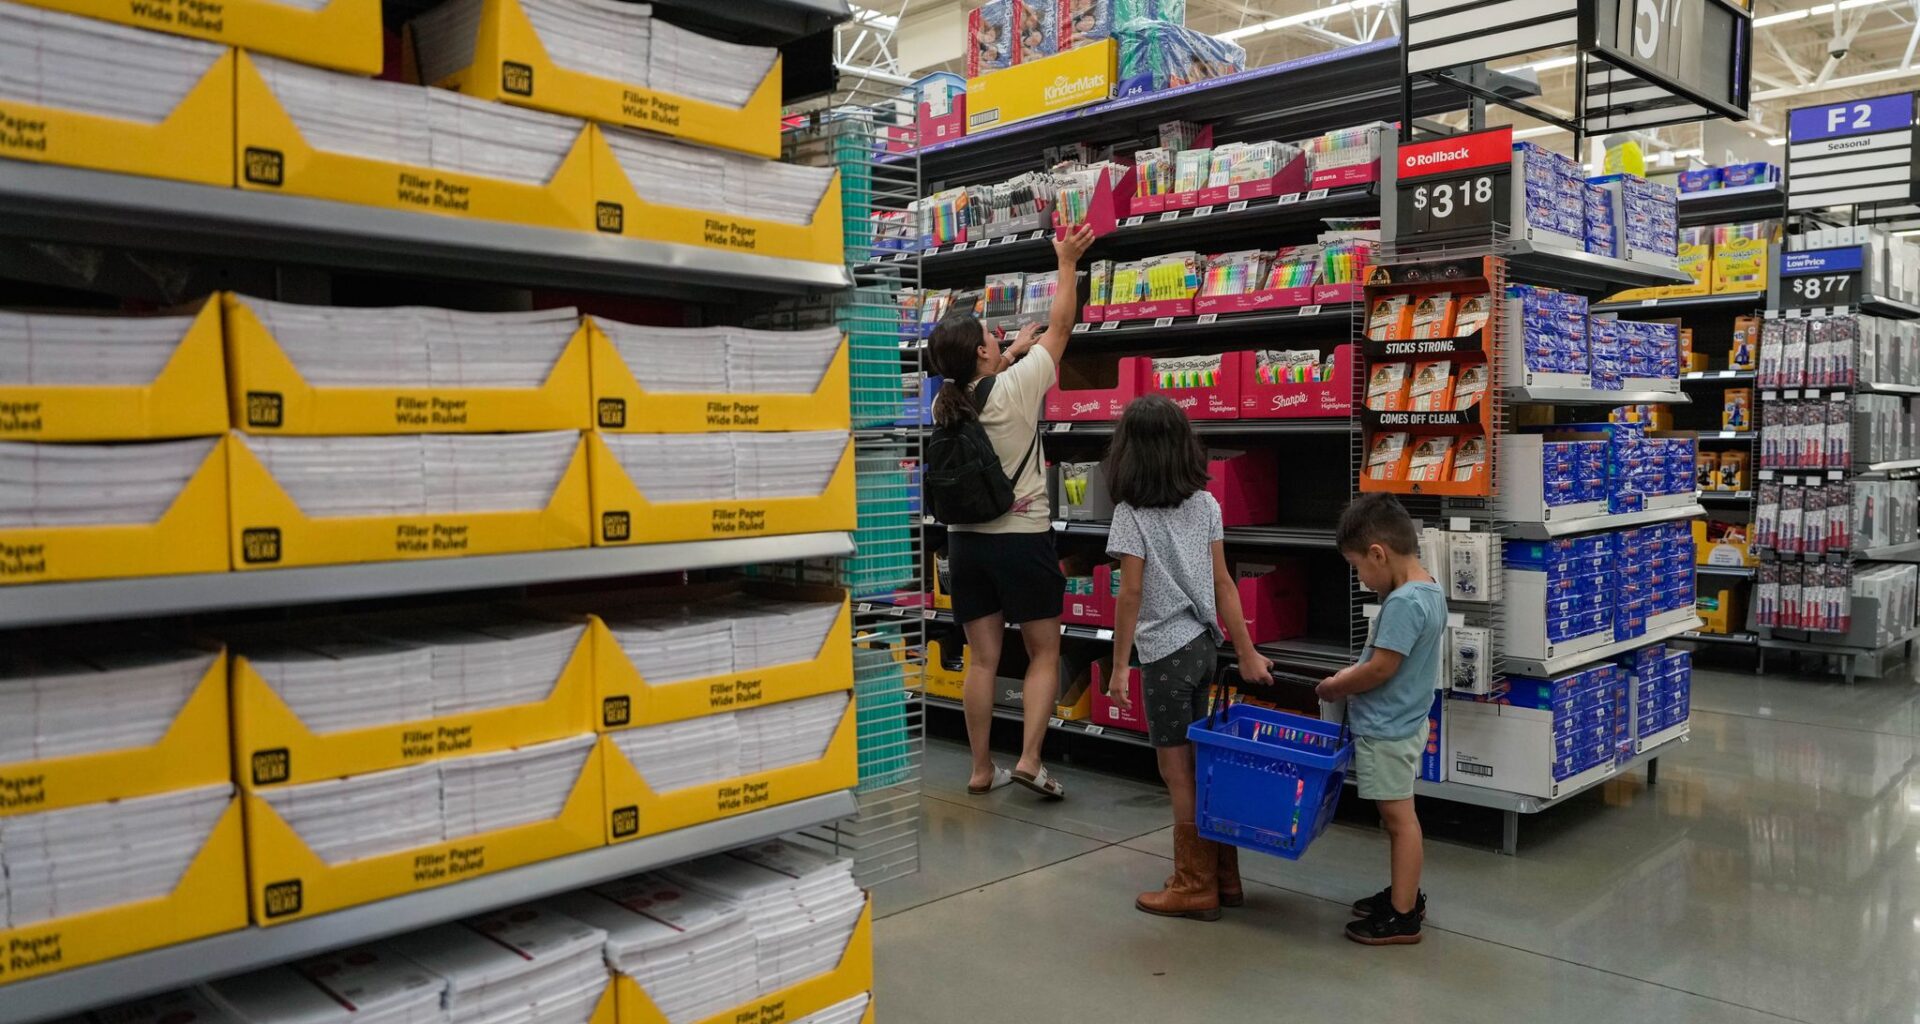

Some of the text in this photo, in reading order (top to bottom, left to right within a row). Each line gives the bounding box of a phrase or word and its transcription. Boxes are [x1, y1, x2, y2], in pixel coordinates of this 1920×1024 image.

[131, 2, 223, 32] Wide Ruled
[1045, 75, 1105, 100] KinderMats
[623, 91, 680, 117] Filler Paper
[622, 105, 680, 126] Wide Ruled
[1828, 104, 1872, 132] F 2
[1828, 138, 1872, 151] Seasonal
[1417, 147, 1469, 166] Rollback
[399, 173, 469, 199] Filler Paper
[398, 189, 469, 210] Wide Ruled
[705, 219, 756, 239] Filler Paper
[704, 232, 756, 249] Wide Ruled
[1787, 258, 1826, 268] Low Price
[1386, 340, 1456, 355] STICKS STRONG.
[396, 397, 467, 414] Filler Paper
[707, 402, 760, 417] Filler Paper
[1071, 400, 1100, 416] Sharpie
[1271, 391, 1308, 411] Sharpie
[0, 402, 42, 420] aper
[396, 411, 467, 424] Wide Ruled
[706, 414, 759, 425] Wide Ruled
[1380, 413, 1460, 424] COMES OFF CLEAN.
[0, 416, 42, 431] uled
[712, 508, 766, 523] Filler Paper
[397, 523, 468, 541] Filler Paper
[712, 520, 765, 532] Wide Ruled
[396, 537, 468, 552] Wide Ruled
[709, 679, 762, 697] Filler Paper
[710, 689, 762, 707] Wide Ruled
[402, 726, 472, 745] Filler Paper
[402, 737, 472, 758] Wide Ruled
[718, 781, 769, 801] Filler Paper
[717, 792, 769, 811] Wide Ruled
[414, 846, 485, 869] Filler Paper
[413, 857, 484, 881] Wide Ruled
[9, 933, 62, 958] Paper
[10, 946, 63, 972] Ruled
[736, 1000, 786, 1024] Filler Paper
